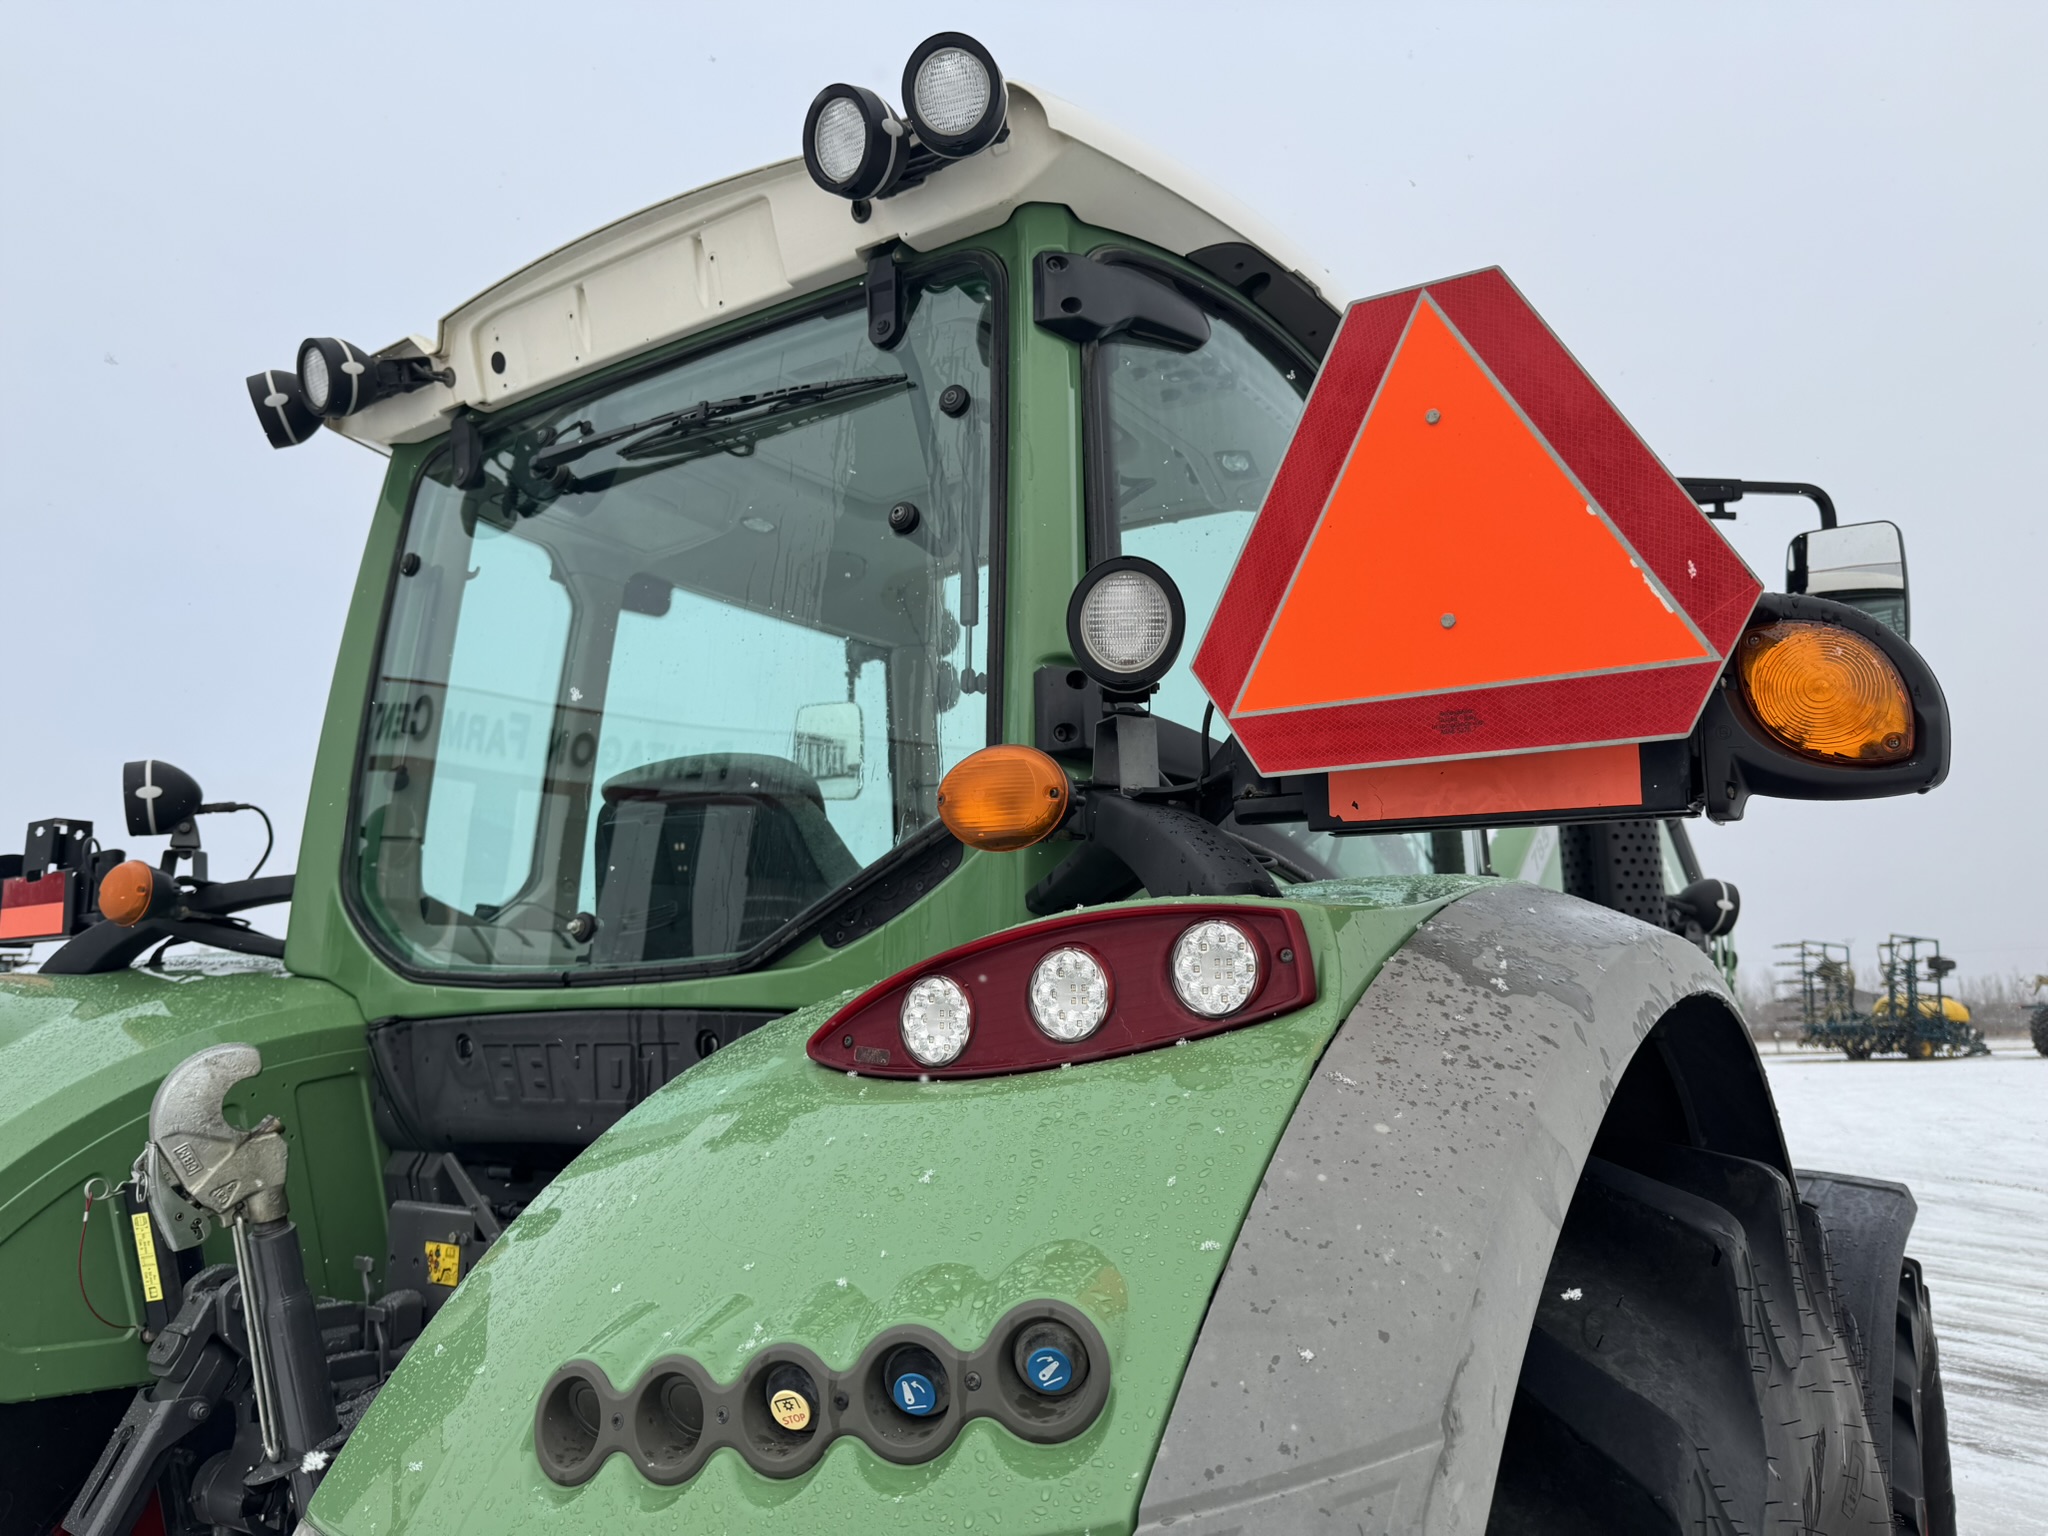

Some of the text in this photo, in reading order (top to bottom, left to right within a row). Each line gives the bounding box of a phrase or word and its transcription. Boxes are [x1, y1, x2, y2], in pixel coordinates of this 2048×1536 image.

[482, 1043, 681, 1103] FENDT
[175, 1144, 201, 1174] CBM
[782, 1413, 806, 1425] STOP
